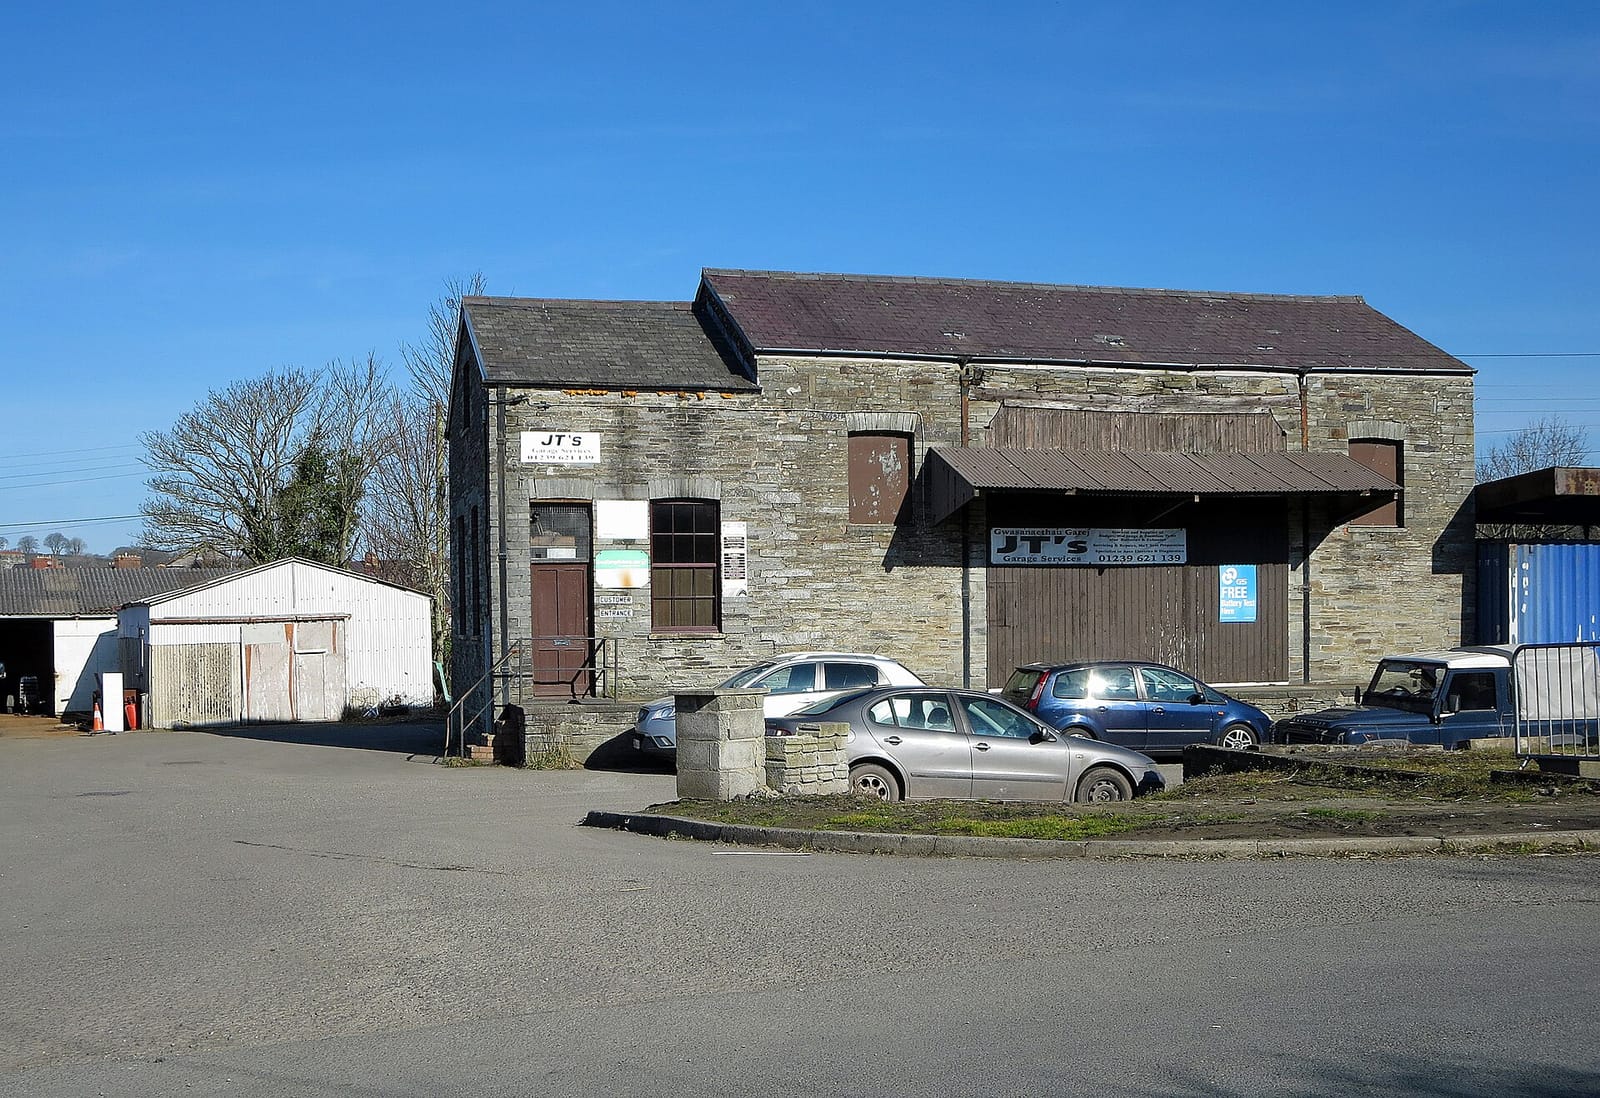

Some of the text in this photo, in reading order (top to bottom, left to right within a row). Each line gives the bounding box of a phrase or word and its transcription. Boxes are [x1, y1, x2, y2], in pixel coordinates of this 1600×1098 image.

[541, 434, 582, 446] JT's
[1065, 528, 1090, 537] Garej
[996, 536, 1089, 553] JT's
[1003, 555, 1037, 563] Garage
[1099, 554, 1181, 562] 01239 621 139
[1222, 586, 1248, 598] FREE
